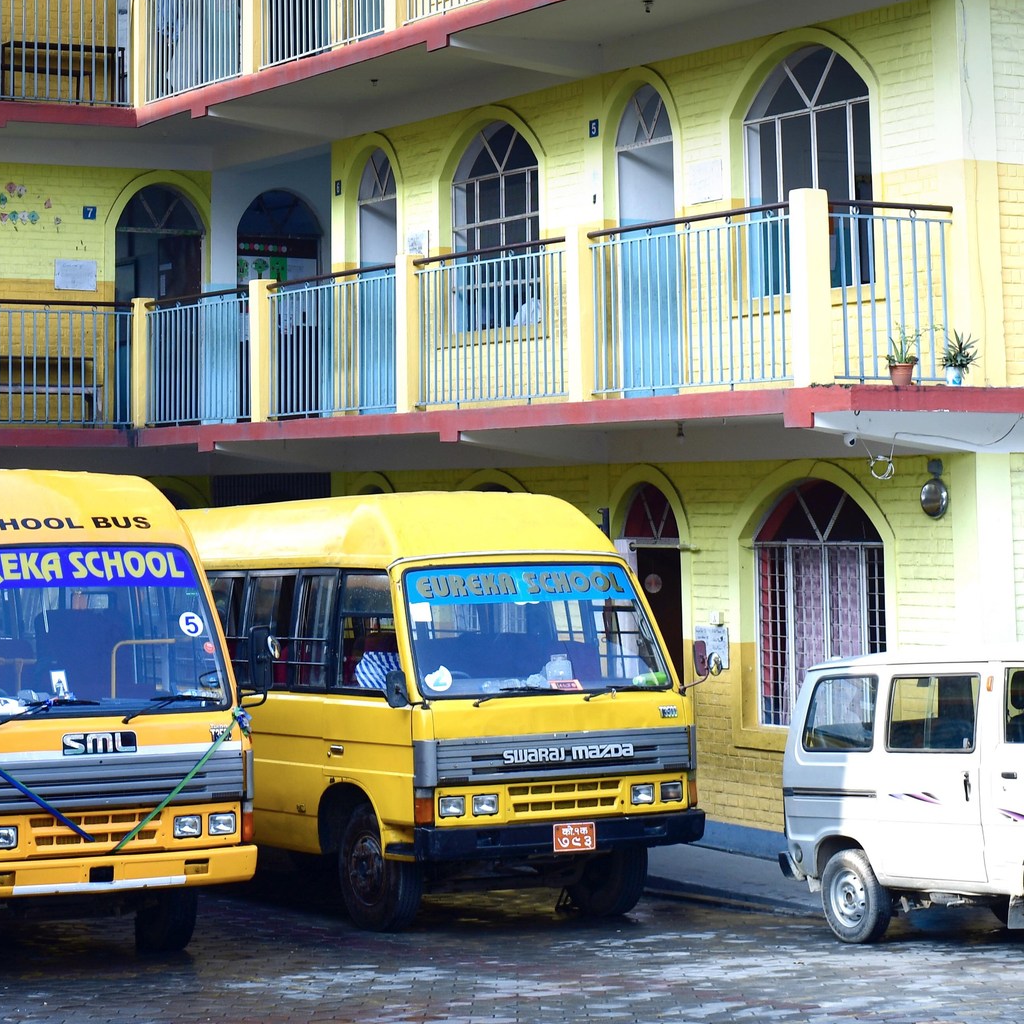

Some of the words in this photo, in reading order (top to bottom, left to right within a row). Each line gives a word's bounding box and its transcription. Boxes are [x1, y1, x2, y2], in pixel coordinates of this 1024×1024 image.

[591, 122, 597, 134] 5
[86, 208, 93, 218] 7
[91, 516, 151, 529] BUS
[68, 551, 185, 582] SCHOOL
[416, 572, 517, 599] EUREKA
[522, 571, 625, 595] SCHOOL
[185, 616, 199, 634] 5
[63, 732, 136, 755] SML
